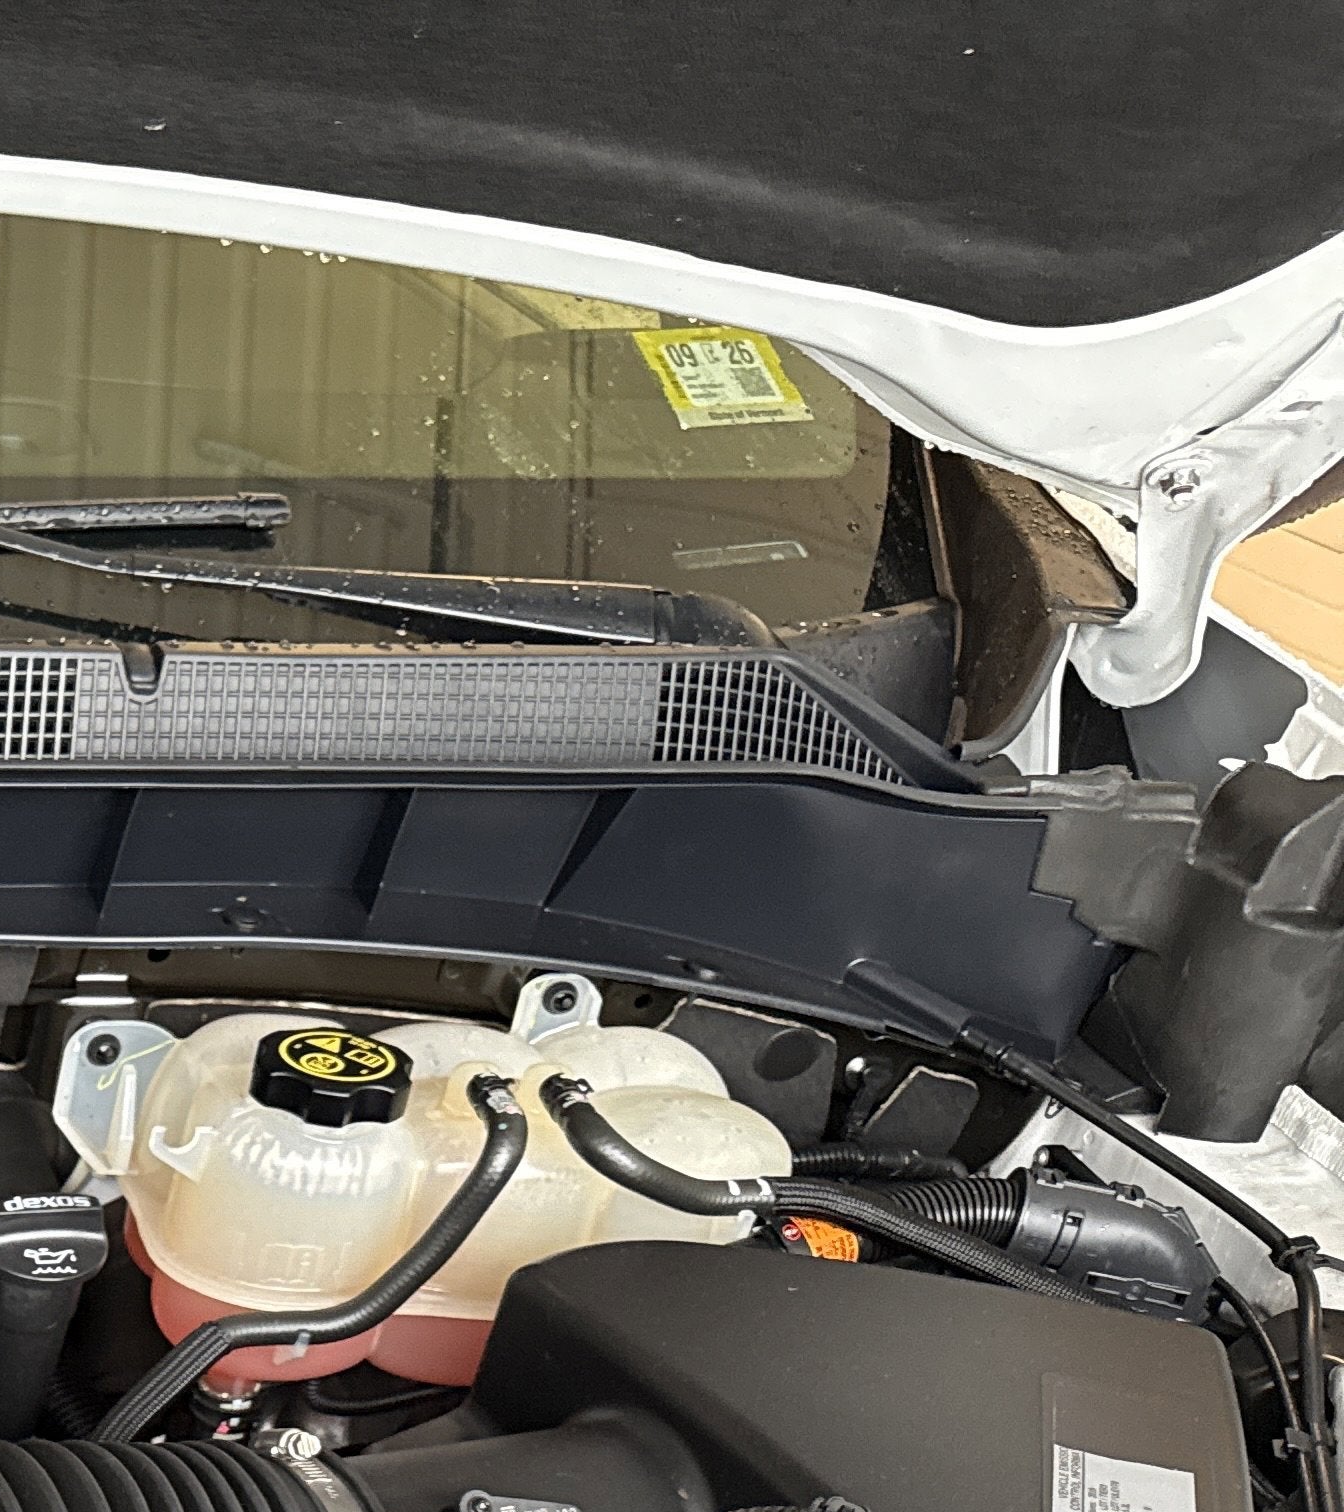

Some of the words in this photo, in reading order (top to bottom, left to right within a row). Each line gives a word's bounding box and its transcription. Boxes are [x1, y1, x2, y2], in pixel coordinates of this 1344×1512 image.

[665, 343, 699, 368] 09
[721, 340, 755, 365] 26
[3, 1195, 91, 1211] dexos
[1058, 1471, 1068, 1499] VEHICLE
[1070, 1480, 1080, 1511] CONTROL
